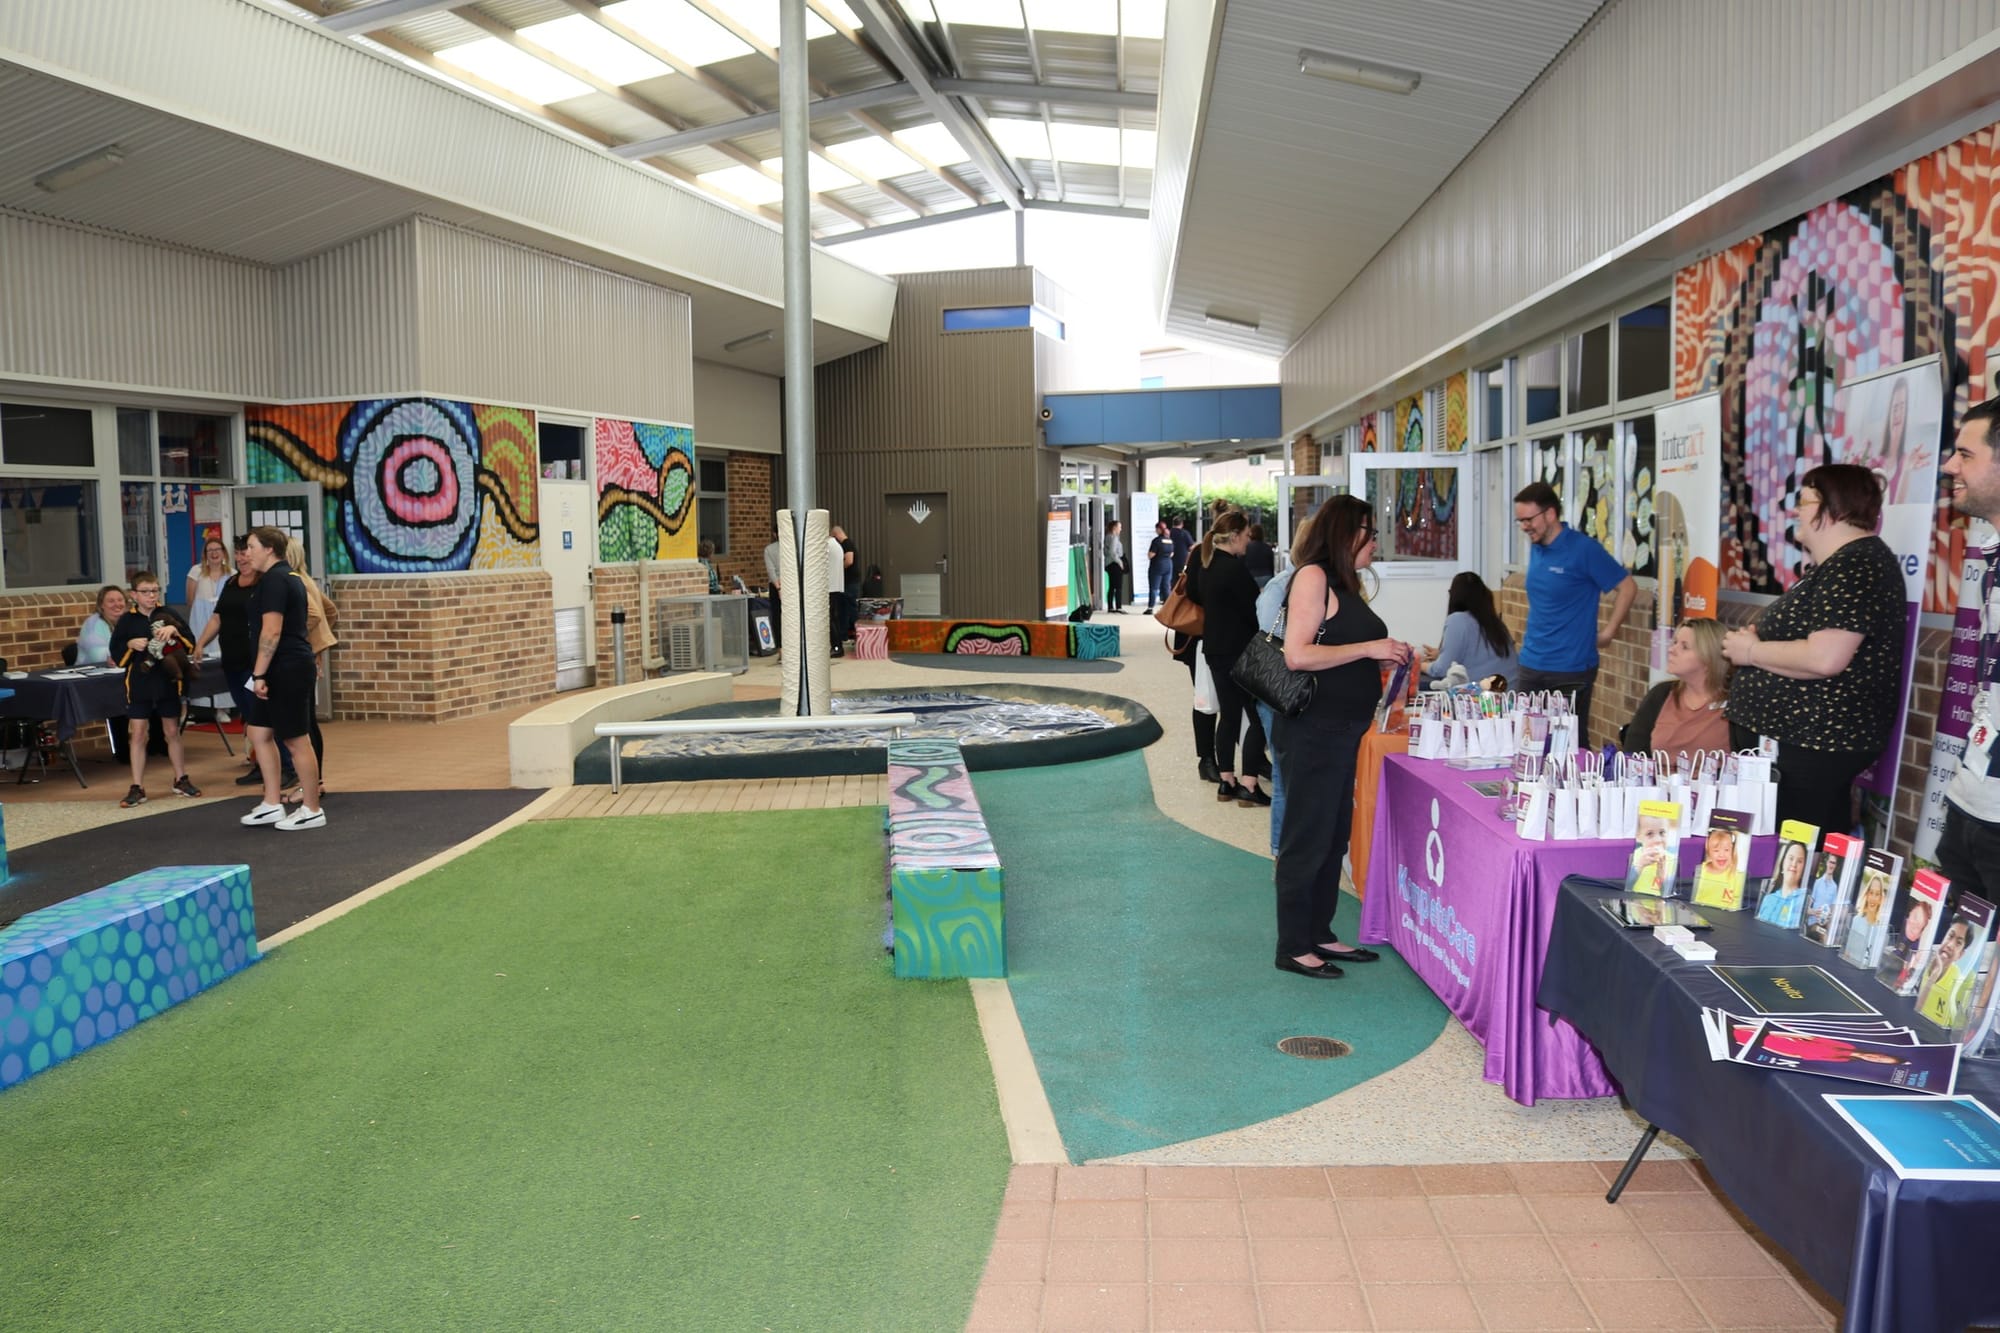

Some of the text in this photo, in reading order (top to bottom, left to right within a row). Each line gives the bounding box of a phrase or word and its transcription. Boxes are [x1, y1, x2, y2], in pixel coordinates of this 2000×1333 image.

[1661, 427, 1705, 461] interact
[1965, 564, 1979, 581] Do
[1946, 676, 1967, 694] Care
[1951, 704, 1973, 723] Hom
[1940, 767, 1957, 782] gro
[1930, 790, 1941, 804] of
[1927, 816, 1945, 832] relia
[1770, 977, 1804, 999] Novita
